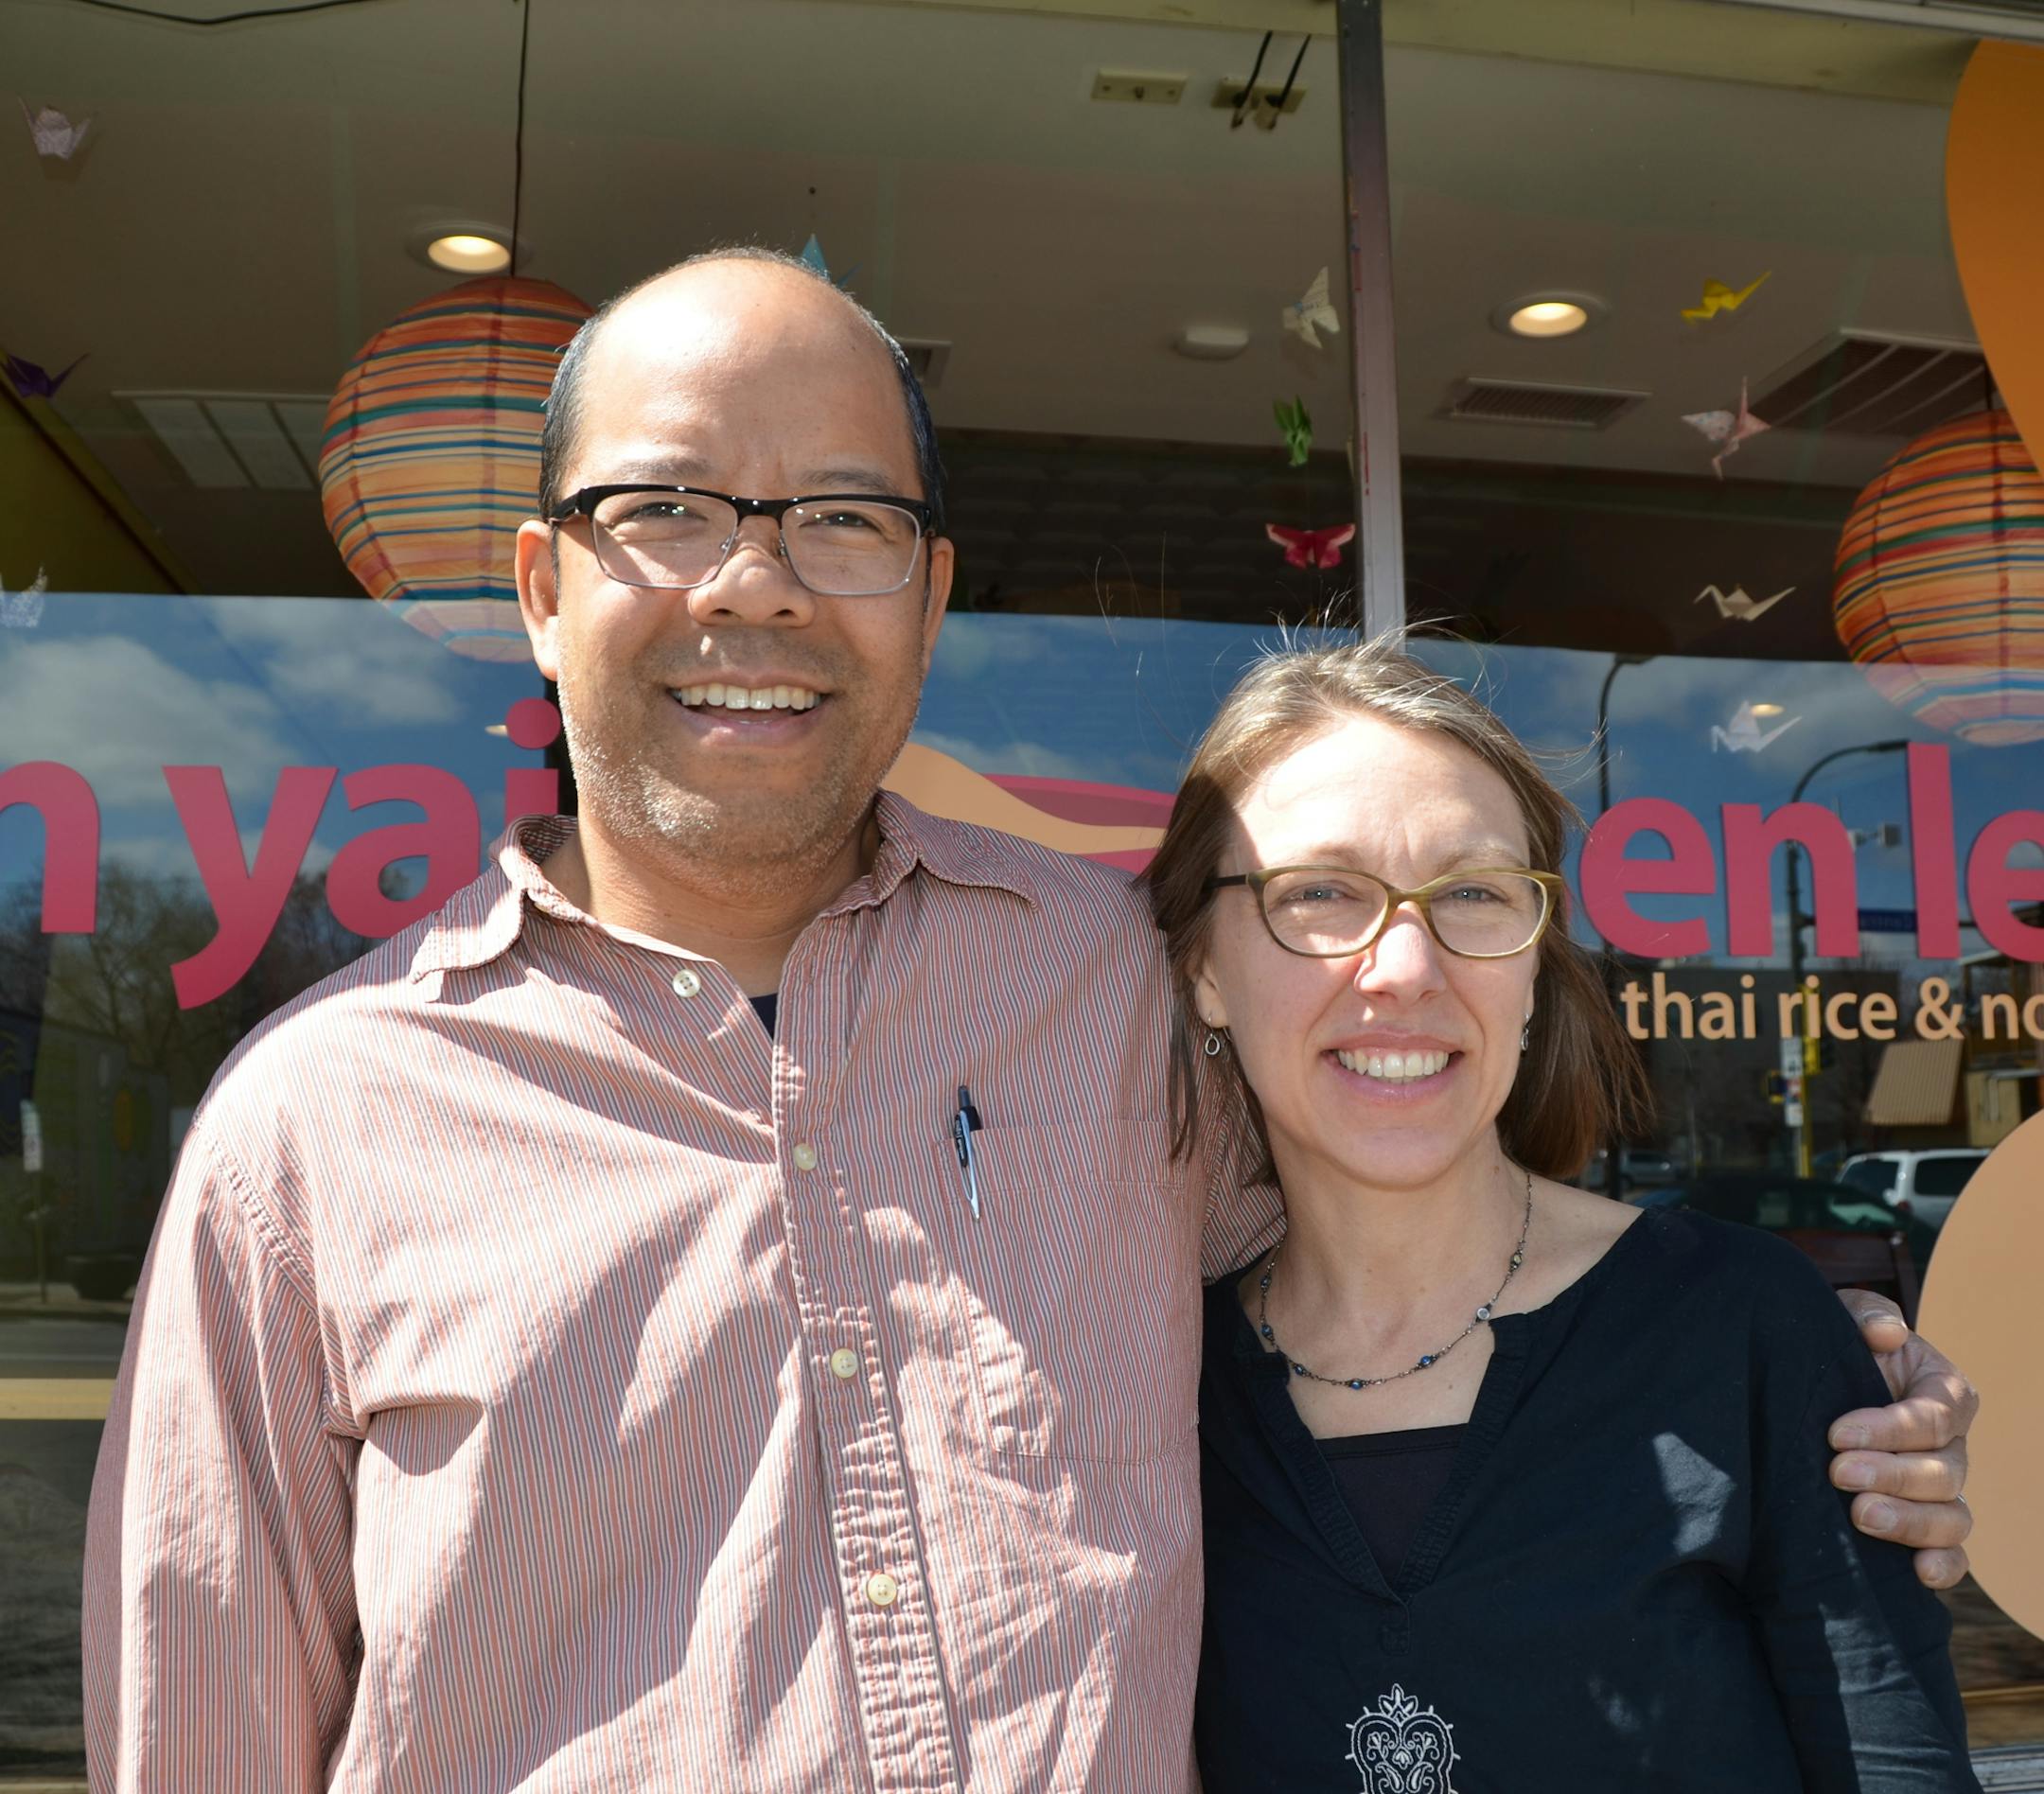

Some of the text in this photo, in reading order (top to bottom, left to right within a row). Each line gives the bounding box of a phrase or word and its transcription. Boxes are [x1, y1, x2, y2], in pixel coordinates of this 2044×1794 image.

[1566, 797, 1860, 958] en
[1620, 972, 1756, 1040] thai
[1778, 975, 1897, 1040] rice
[1915, 976, 1965, 1040] &
